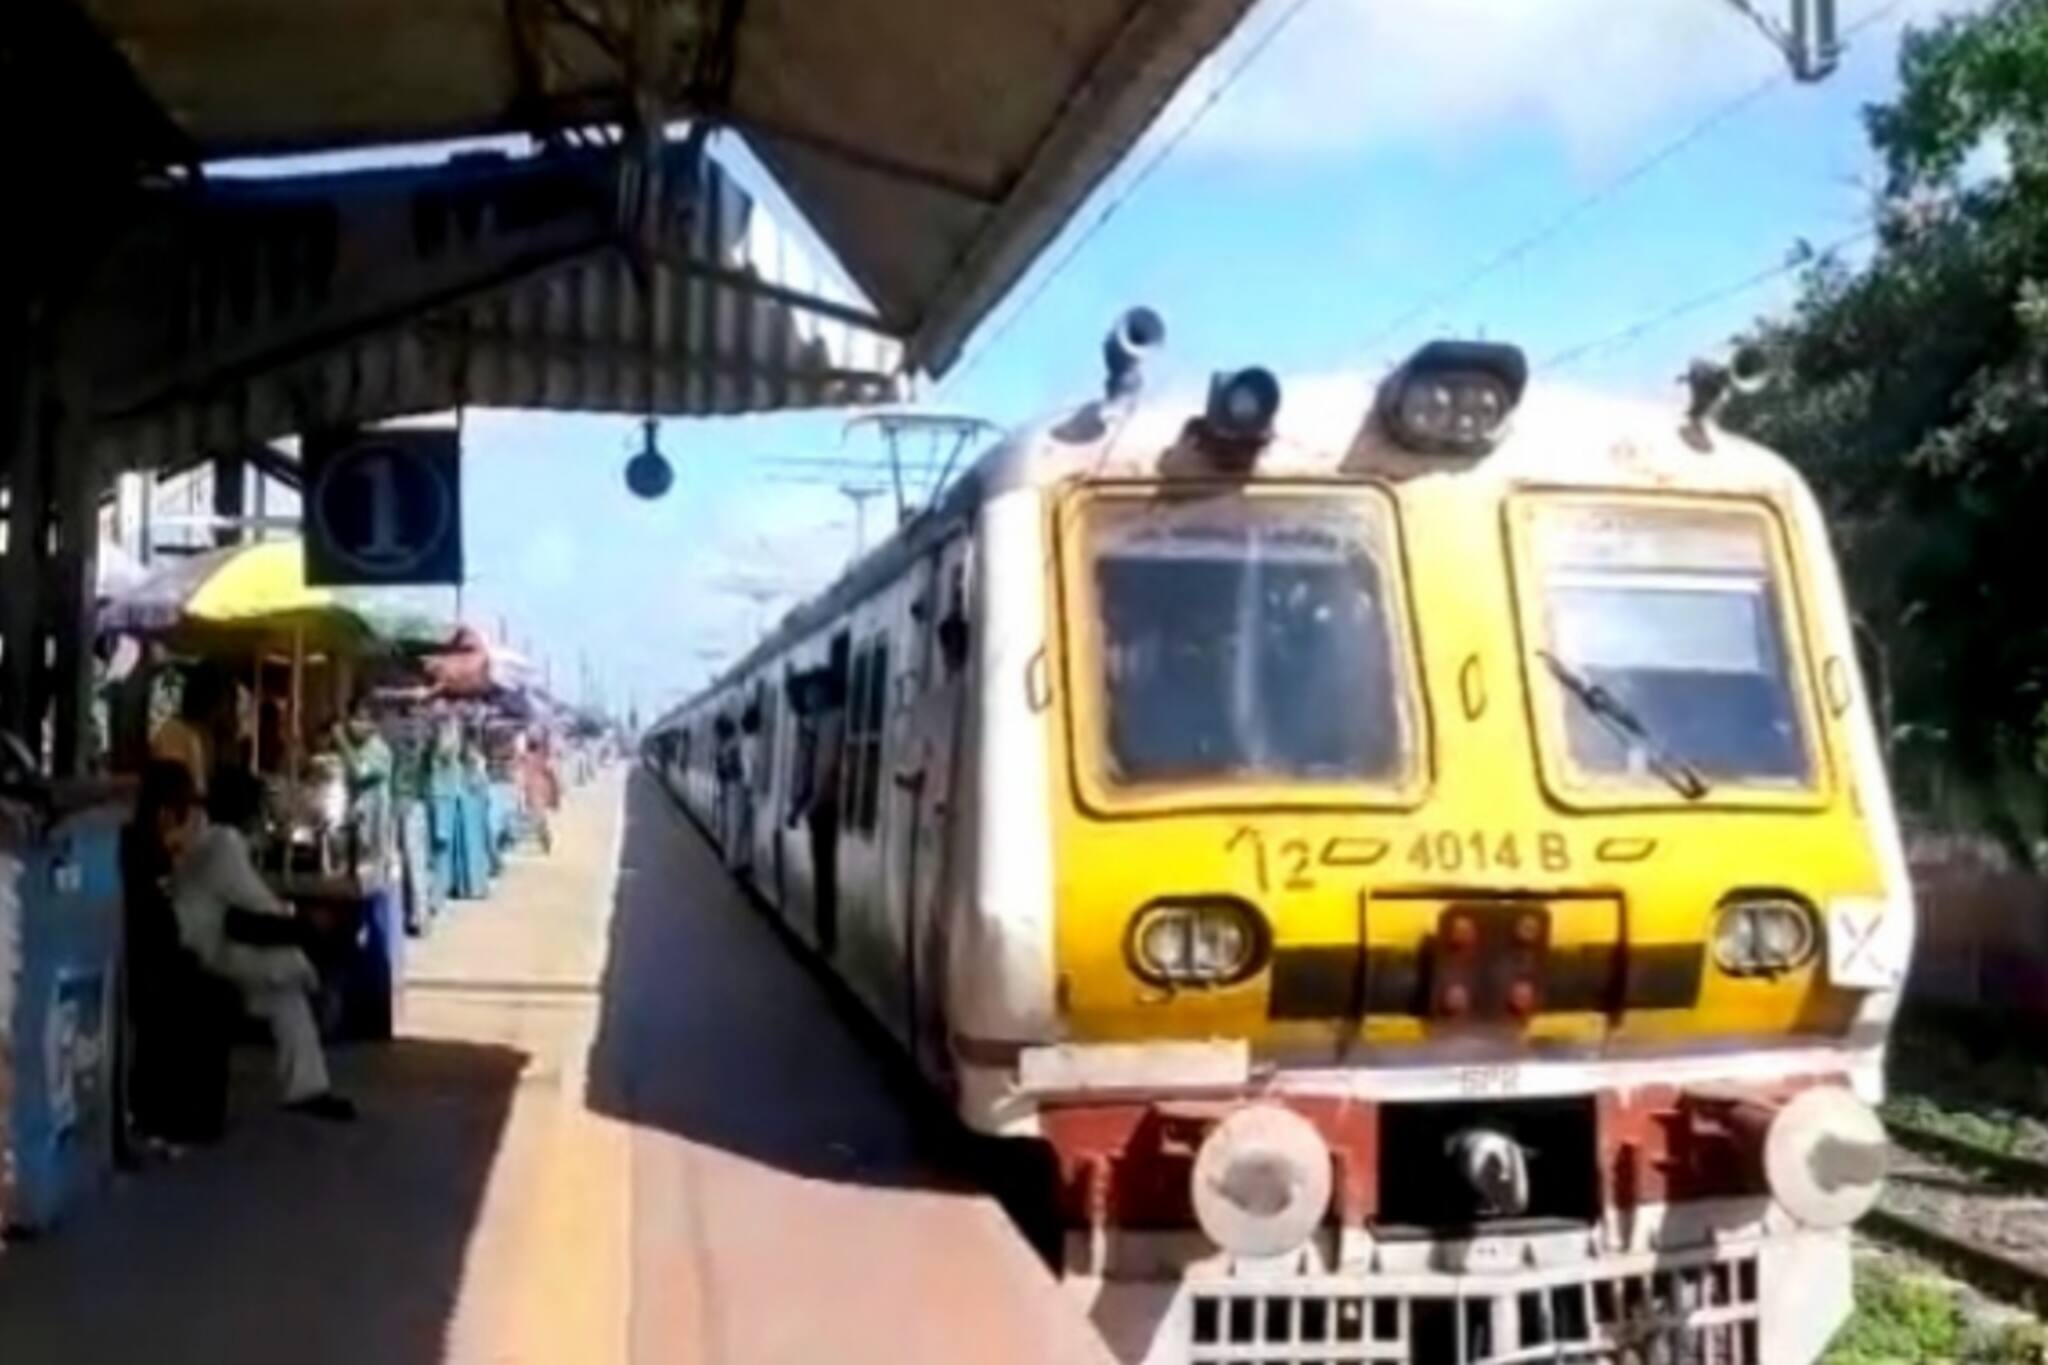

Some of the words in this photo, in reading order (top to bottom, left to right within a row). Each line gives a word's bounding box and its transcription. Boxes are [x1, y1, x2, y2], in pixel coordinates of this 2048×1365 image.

[354, 456, 413, 555] 1
[1406, 830, 1521, 872] 4014
[1538, 831, 1571, 872] B
